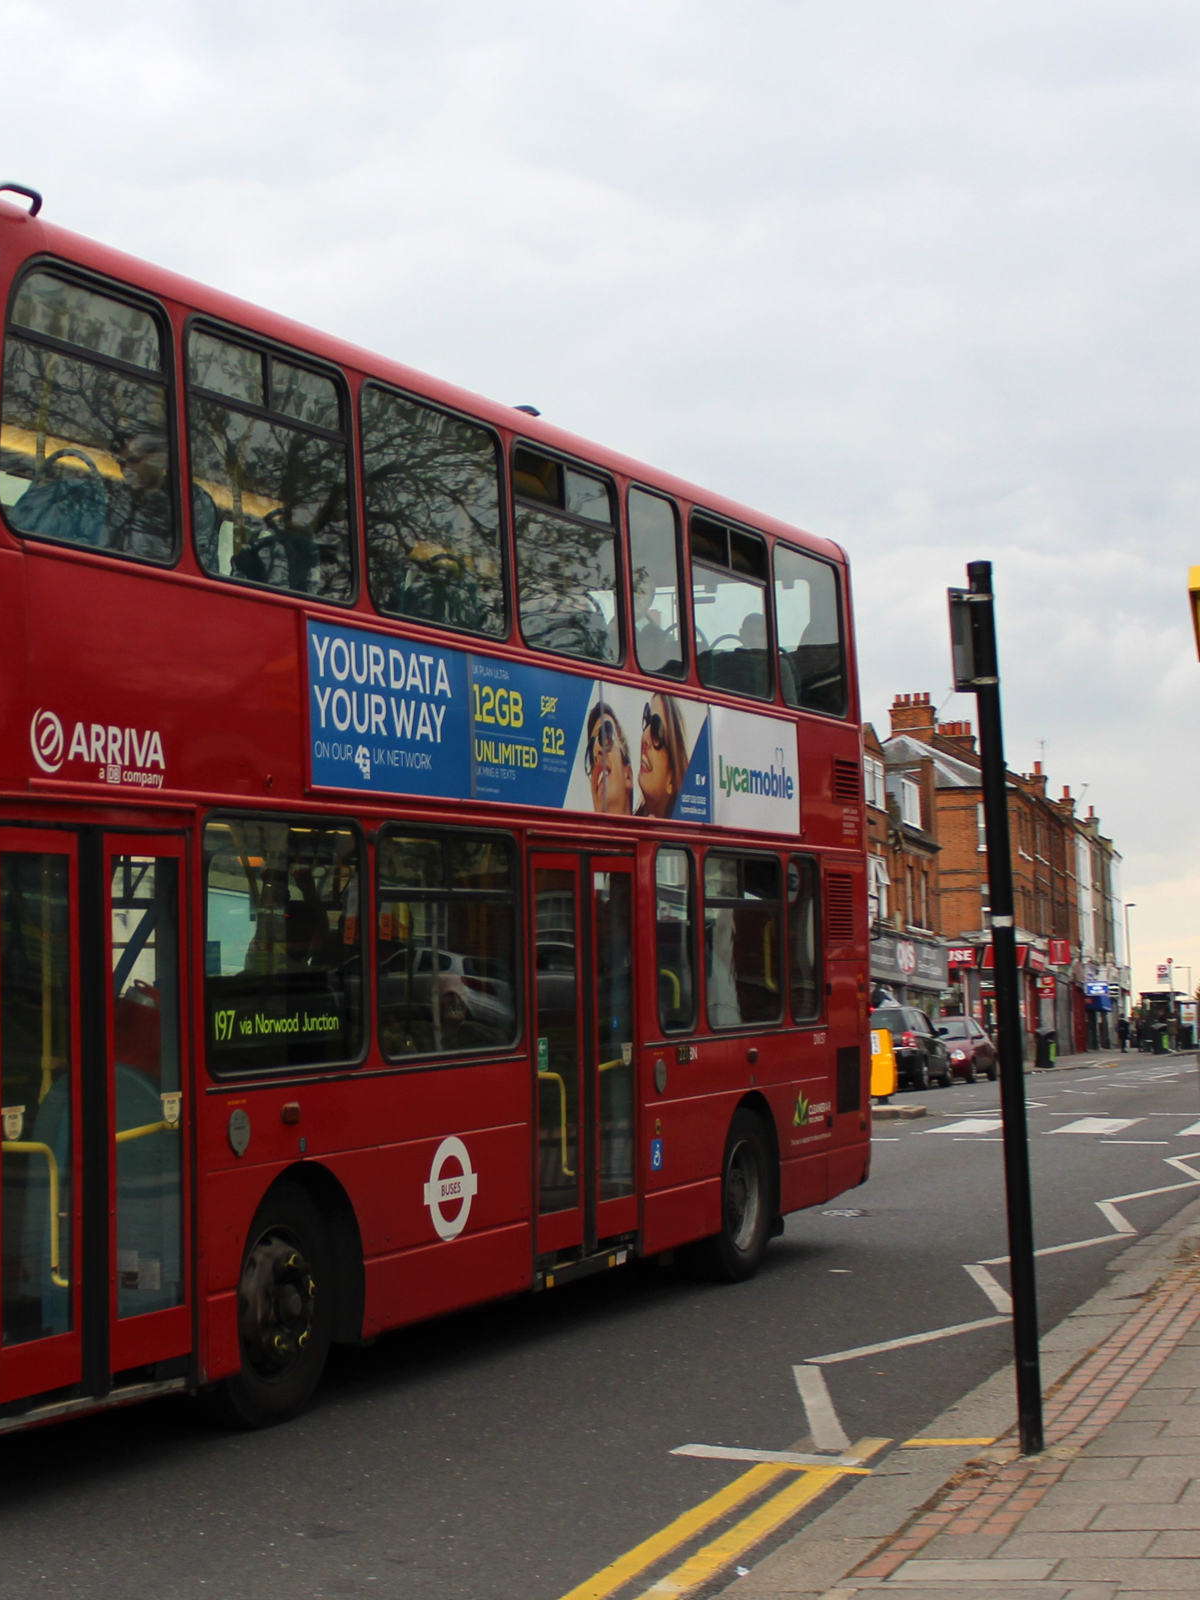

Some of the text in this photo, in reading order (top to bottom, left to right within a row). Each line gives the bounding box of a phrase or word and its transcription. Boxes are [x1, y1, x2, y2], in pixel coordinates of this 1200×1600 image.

[312, 634, 452, 698] YOUR DATA
[313, 684, 447, 743] YOUR WAY
[473, 683, 524, 728] 12GB
[67, 722, 166, 769] ARRIVA
[314, 740, 329, 758] ON
[332, 742, 353, 761] OUR
[373, 748, 386, 765] UK
[387, 750, 432, 770] NETWORK
[475, 738, 538, 768] UNLIMITED
[542, 726, 565, 755] £12
[98, 767, 105, 779] a
[122, 770, 164, 789] company
[718, 754, 794, 800] Lycamobile
[215, 1010, 339, 1040] 197 via Norwood Junction
[441, 1181, 461, 1197] BUSES
